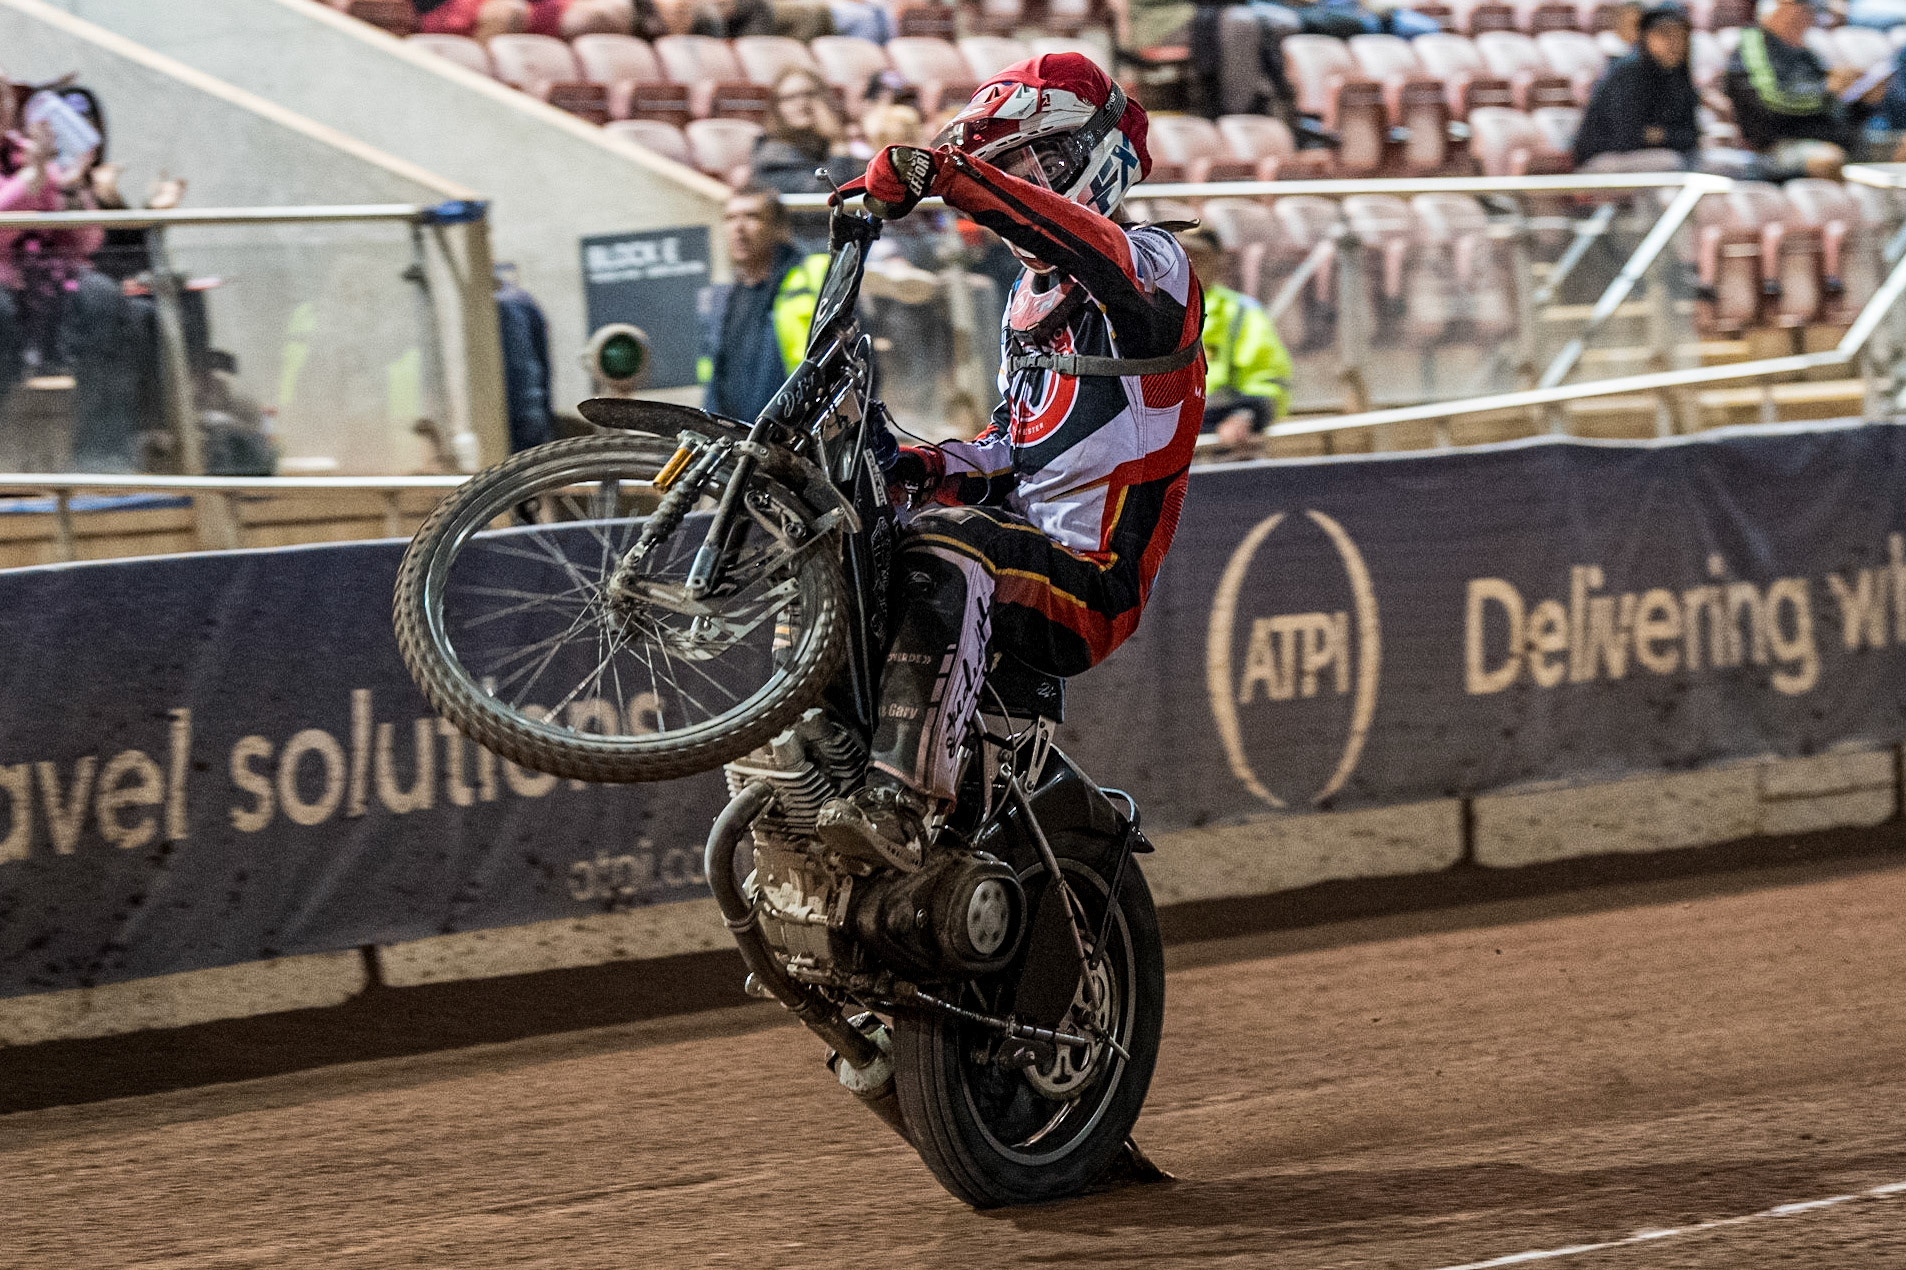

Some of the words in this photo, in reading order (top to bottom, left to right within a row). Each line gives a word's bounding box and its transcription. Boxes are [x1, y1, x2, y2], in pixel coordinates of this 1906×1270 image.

[908, 148, 931, 197] EFFORT
[1239, 611, 1350, 704] ATPI
[1464, 553, 1820, 696] Delivering
[888, 702, 919, 719] Gary
